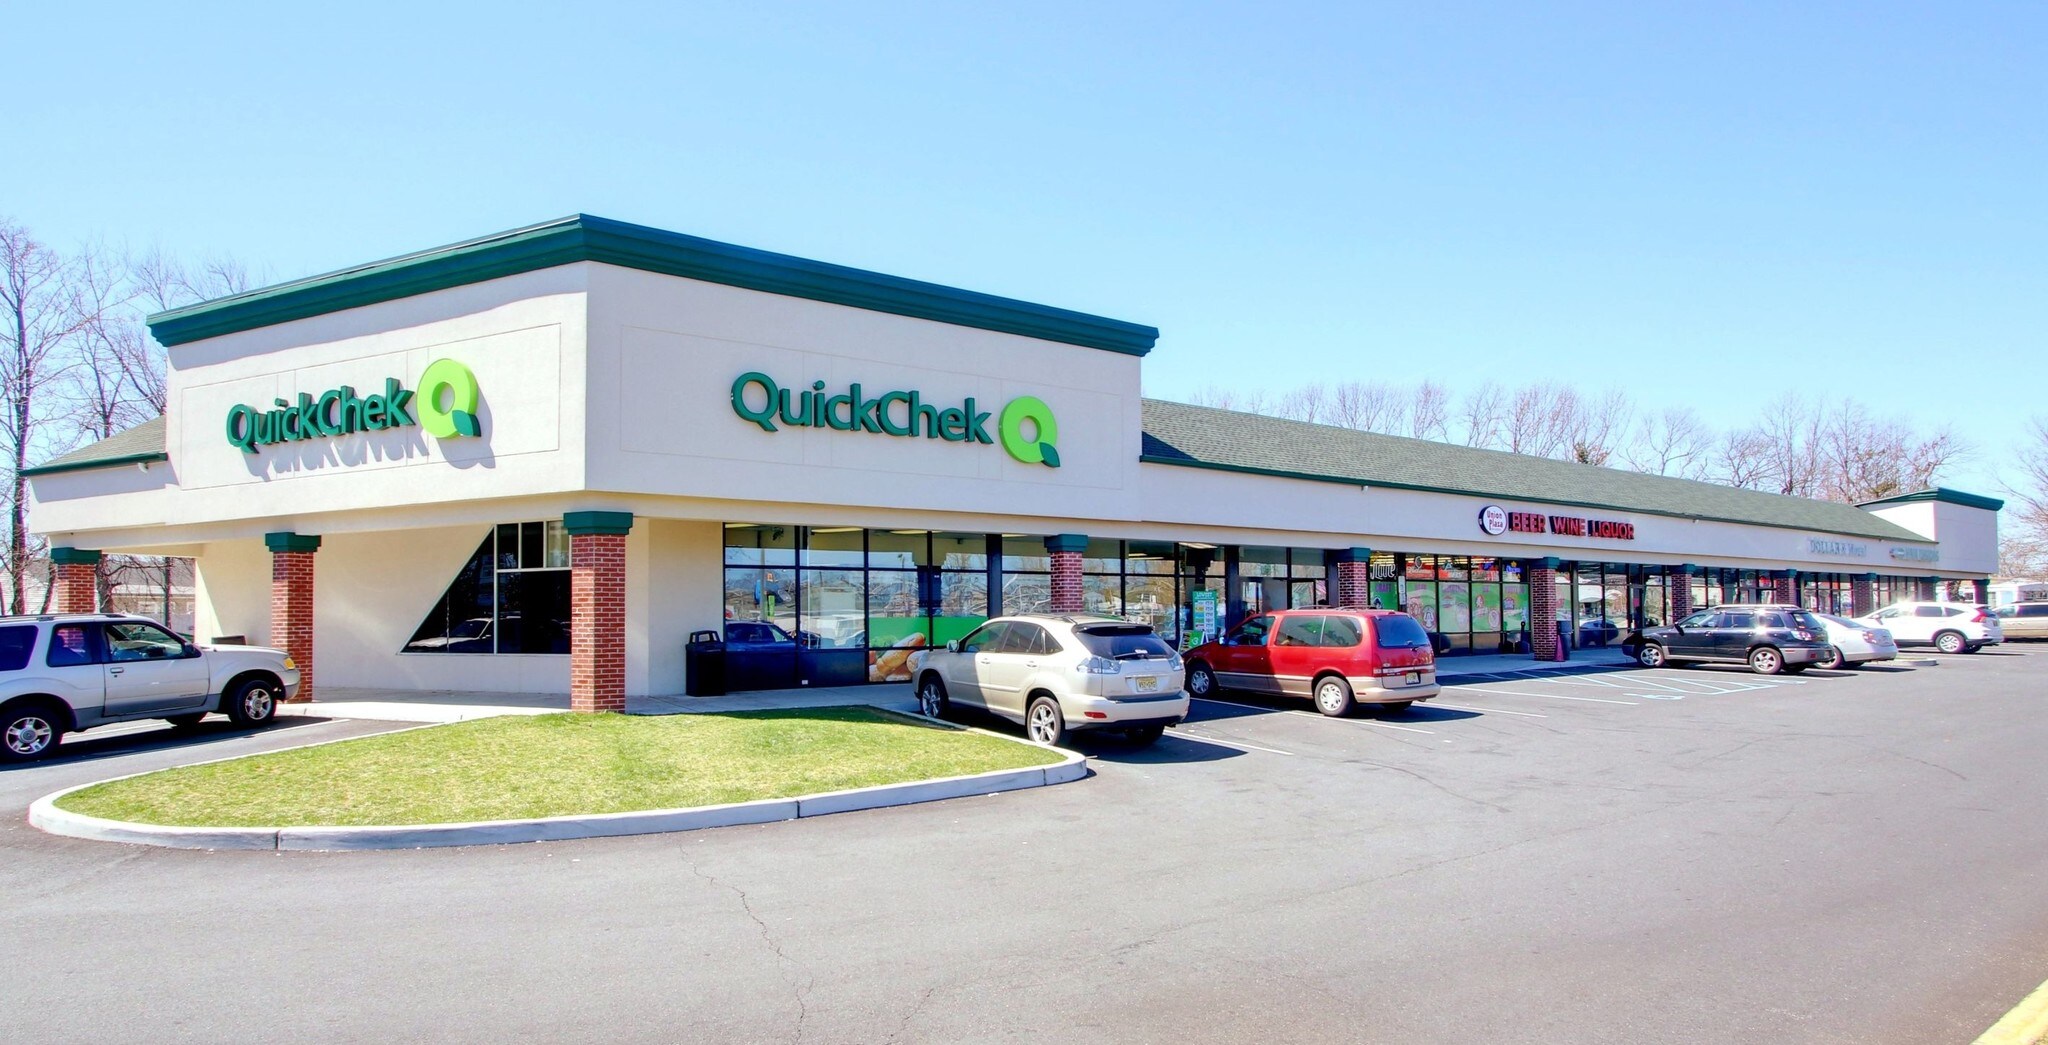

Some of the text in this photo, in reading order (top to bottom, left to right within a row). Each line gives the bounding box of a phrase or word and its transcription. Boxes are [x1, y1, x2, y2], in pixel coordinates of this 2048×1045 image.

[226, 377, 415, 454] QuickChek
[731, 372, 993, 444] QuickChek
[1486, 510, 1502, 519] Union
[1489, 518, 1503, 529] Plaza
[1508, 512, 1635, 539] BEER WINE LIQUOR
